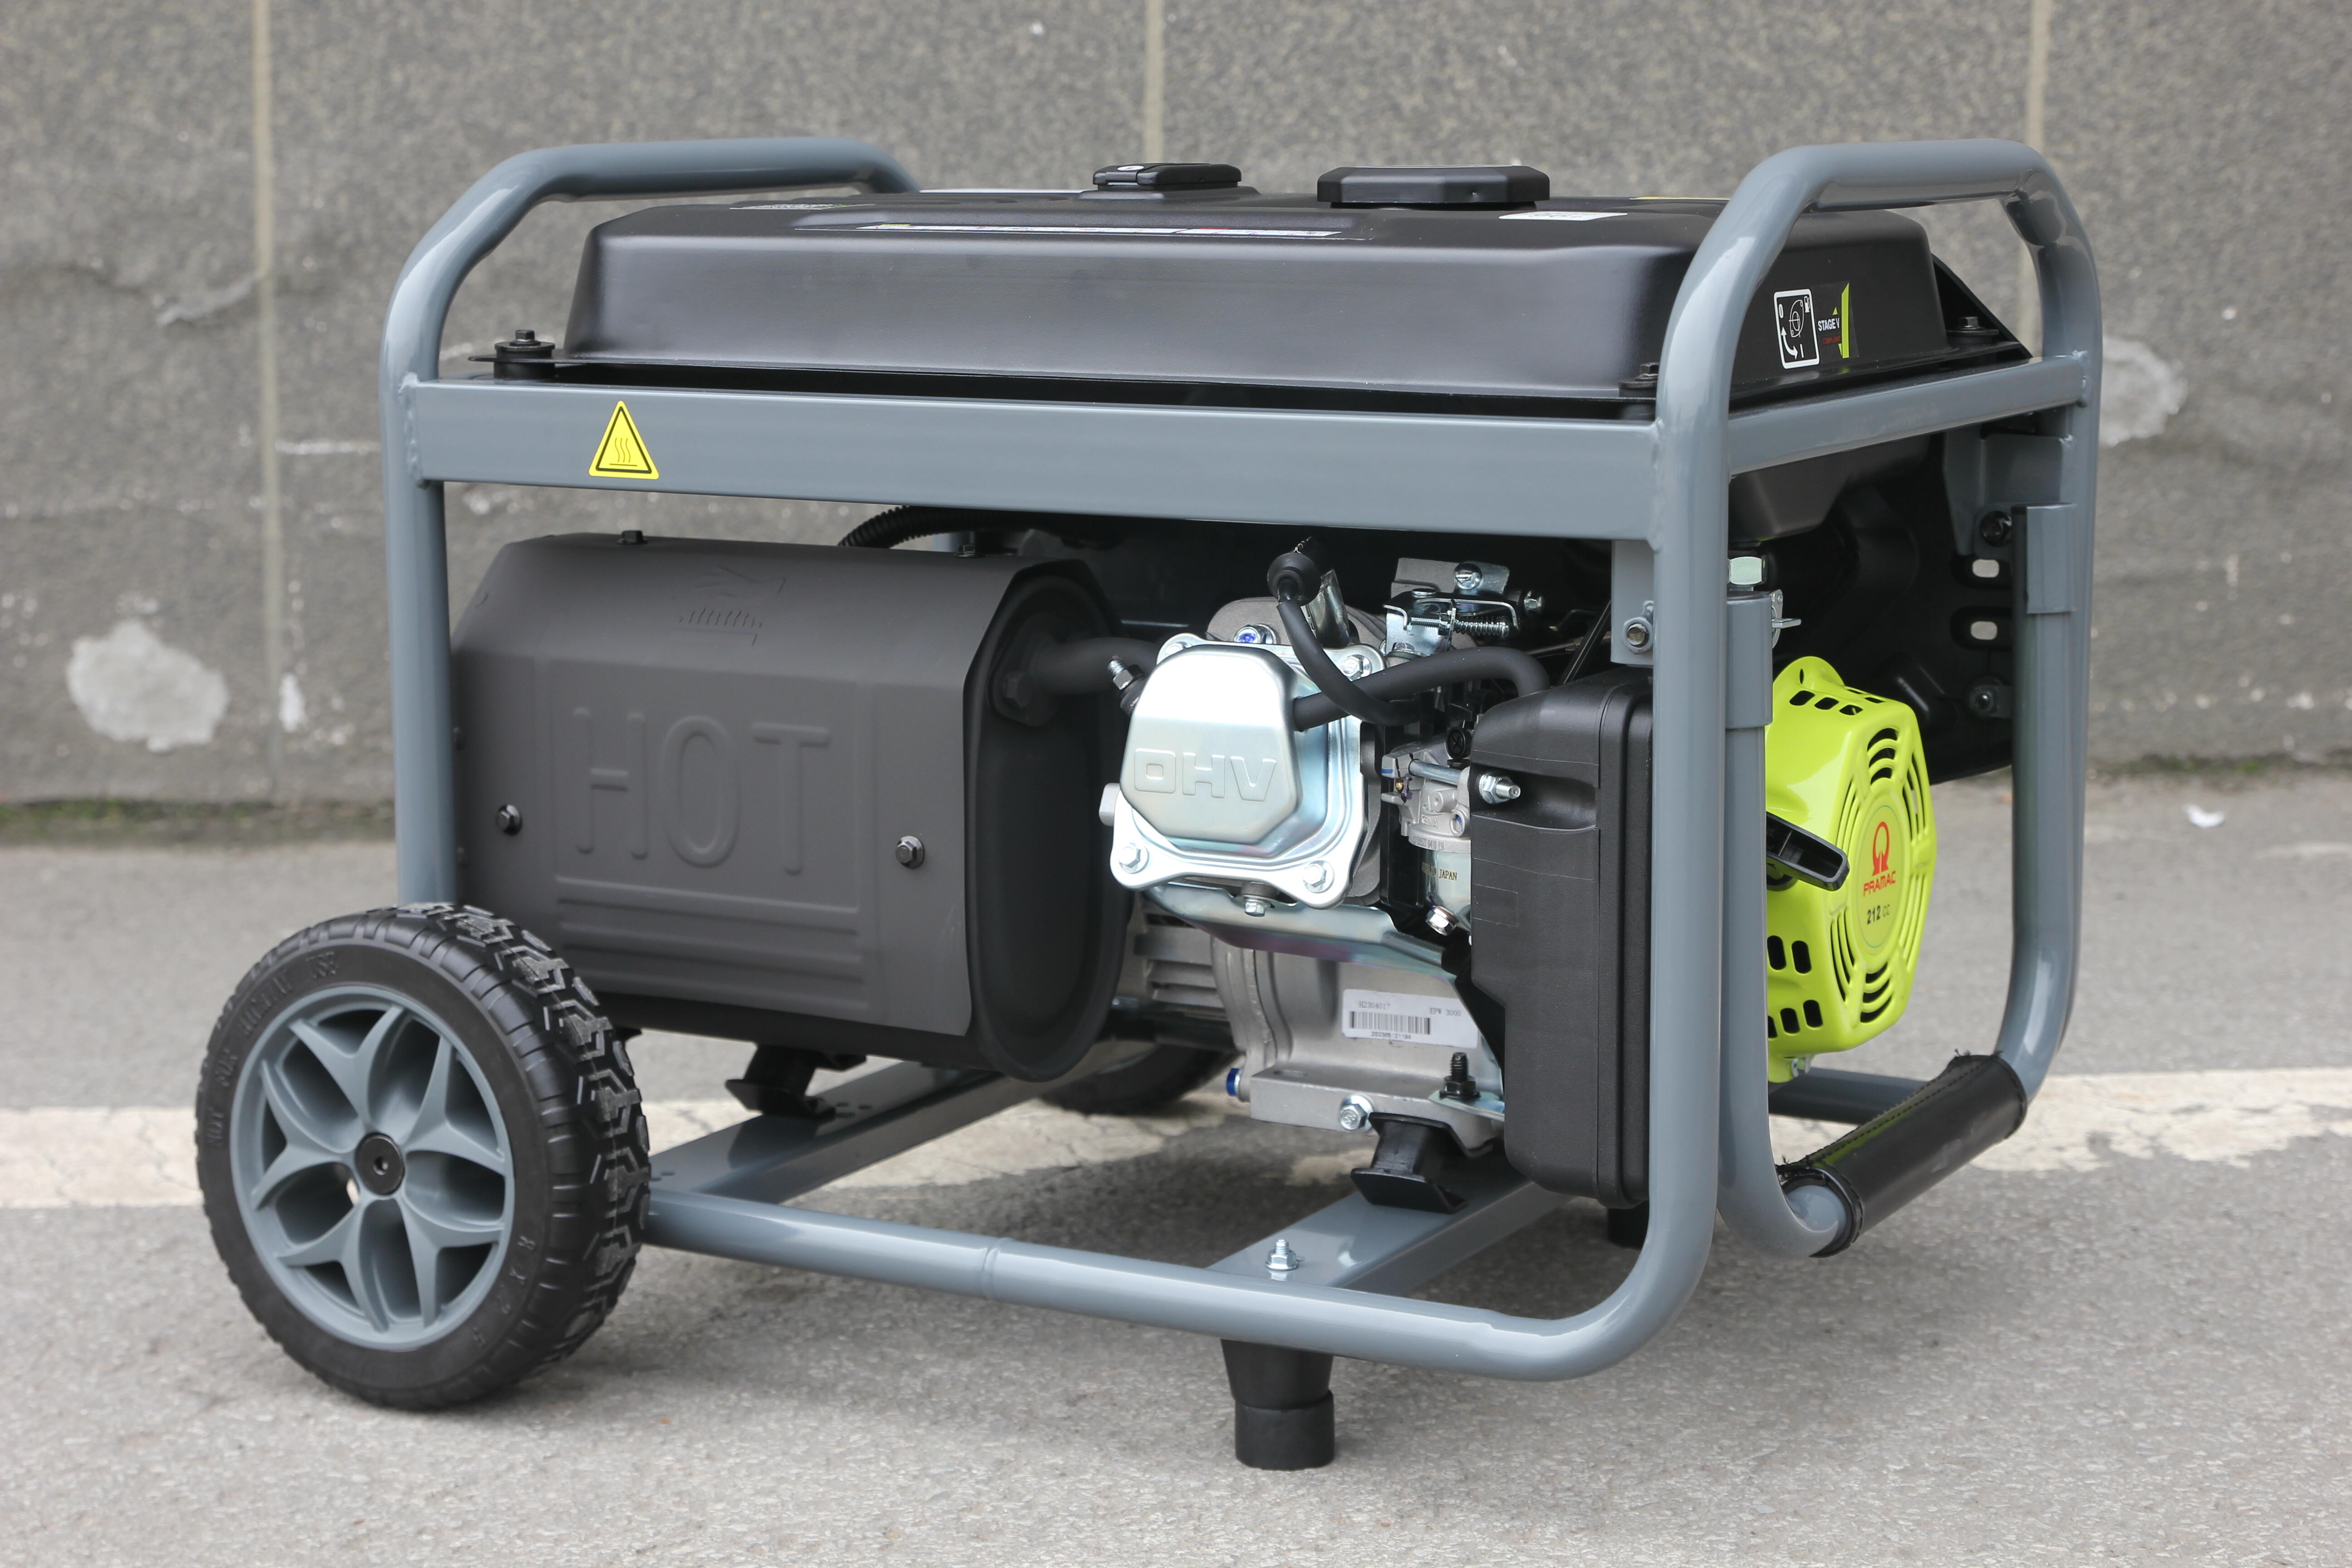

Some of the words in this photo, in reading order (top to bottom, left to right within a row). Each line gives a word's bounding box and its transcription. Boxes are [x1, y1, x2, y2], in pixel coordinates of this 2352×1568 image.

[1818, 318, 1836, 331] STAGE
[1835, 318, 1840, 328] V
[1134, 747, 1277, 803] OHV
[573, 707, 830, 875] HOT
[1439, 868, 1458, 881] JAPAN
[1863, 870, 1896, 897] PRAMAC
[1867, 905, 1881, 925] 212
[1446, 1009, 1462, 1017] 3000
[208, 1104, 225, 1148] NOT
